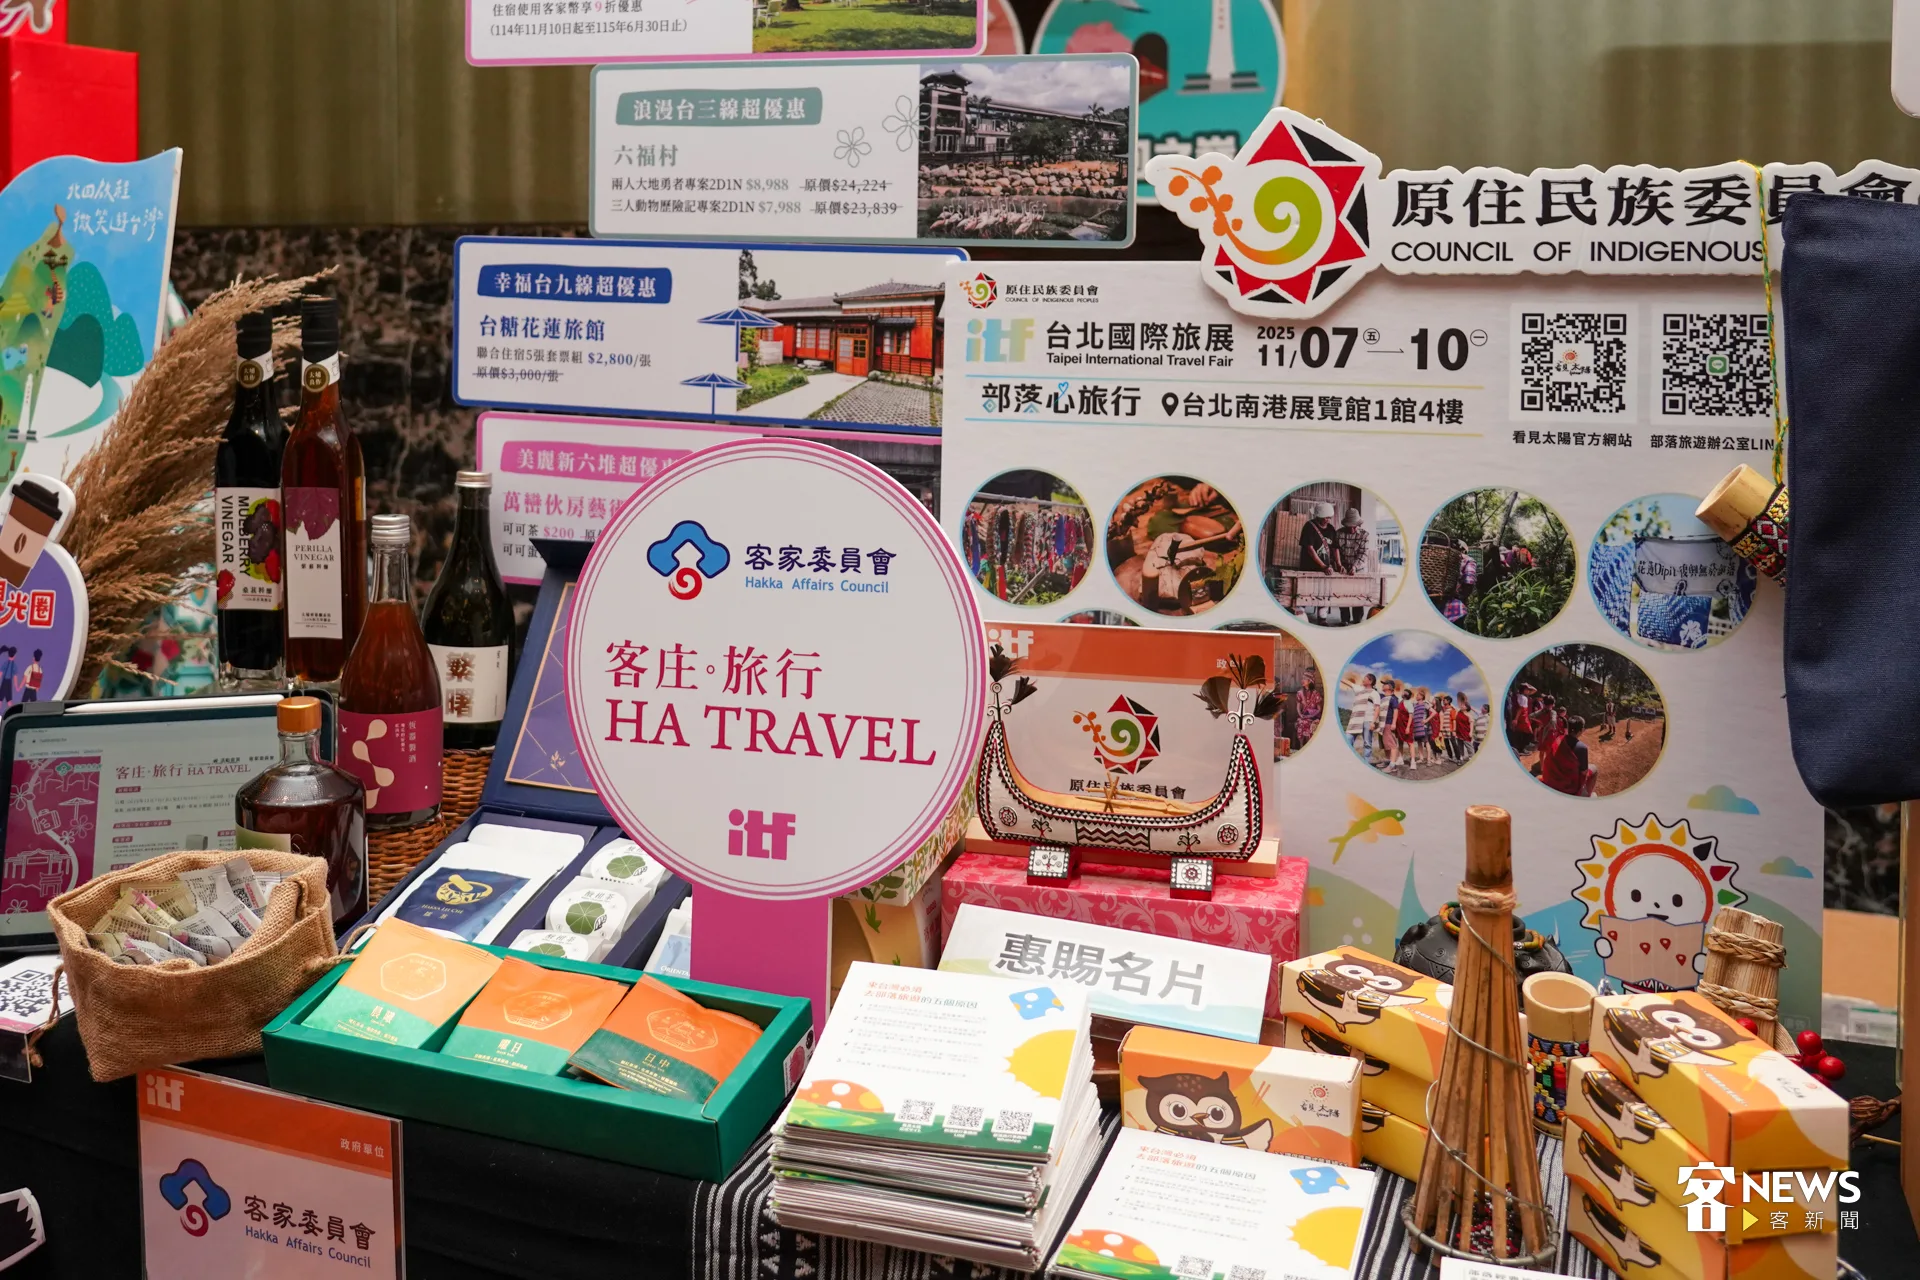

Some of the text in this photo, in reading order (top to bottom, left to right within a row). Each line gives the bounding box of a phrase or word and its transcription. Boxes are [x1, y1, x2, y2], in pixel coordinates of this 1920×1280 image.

[632, 97, 806, 120] 浪漫台三線超優惠
[614, 144, 679, 167] 六福村
[611, 177, 743, 191] 兩人大地勇者專案2D1N
[746, 179, 789, 192] $8,988
[611, 199, 755, 213] 三人動物歷險記專案2D1N
[758, 201, 801, 215] $7,988
[1391, 241, 1514, 262] COUNCIL
[1533, 241, 1571, 261] OF
[494, 271, 657, 298] 幸福台九線超優惠
[1005, 284, 1099, 296] 原住民族委員會
[480, 314, 605, 341] 台糖花蓮旅館
[1046, 320, 1234, 351] 台北國際旅展
[1257, 326, 1295, 340] 2025
[966, 318, 1034, 363] itf
[1410, 328, 1469, 371] 10
[476, 346, 651, 368] 聯合住宿5張套票組 $2,800/張
[1047, 352, 1234, 367] Taipei International Travel Fair
[982, 382, 1141, 416] 部落心旅行
[1183, 392, 1464, 424] 台北南港展覽館1館4樓
[1512, 431, 1632, 448] 看見太陽官方網站
[1650, 434, 1781, 451] 部落旅遊辦公室LIN
[221, 496, 234, 563] VINEGAR
[503, 522, 538, 537] 可可茶
[543, 526, 575, 539] $200
[294, 554, 335, 562] VINEGAR
[295, 544, 333, 552] PERILLA
[744, 543, 897, 576] 客家委員會
[745, 576, 889, 593] Hakka Affairs Council
[604, 698, 937, 766] HA TRAVEL
[188, 766, 204, 776] HA
[207, 763, 250, 775] TRAVEL
[728, 808, 796, 860] itf
[660, 965, 690, 977] ORIENTA
[995, 932, 1204, 1006] 惠賜名片
[146, 1074, 185, 1112] itf
[340, 1138, 385, 1158] 政府單位
[243, 1195, 375, 1250] 客家委員會
[245, 1225, 371, 1268] Hakka Affairs Council
